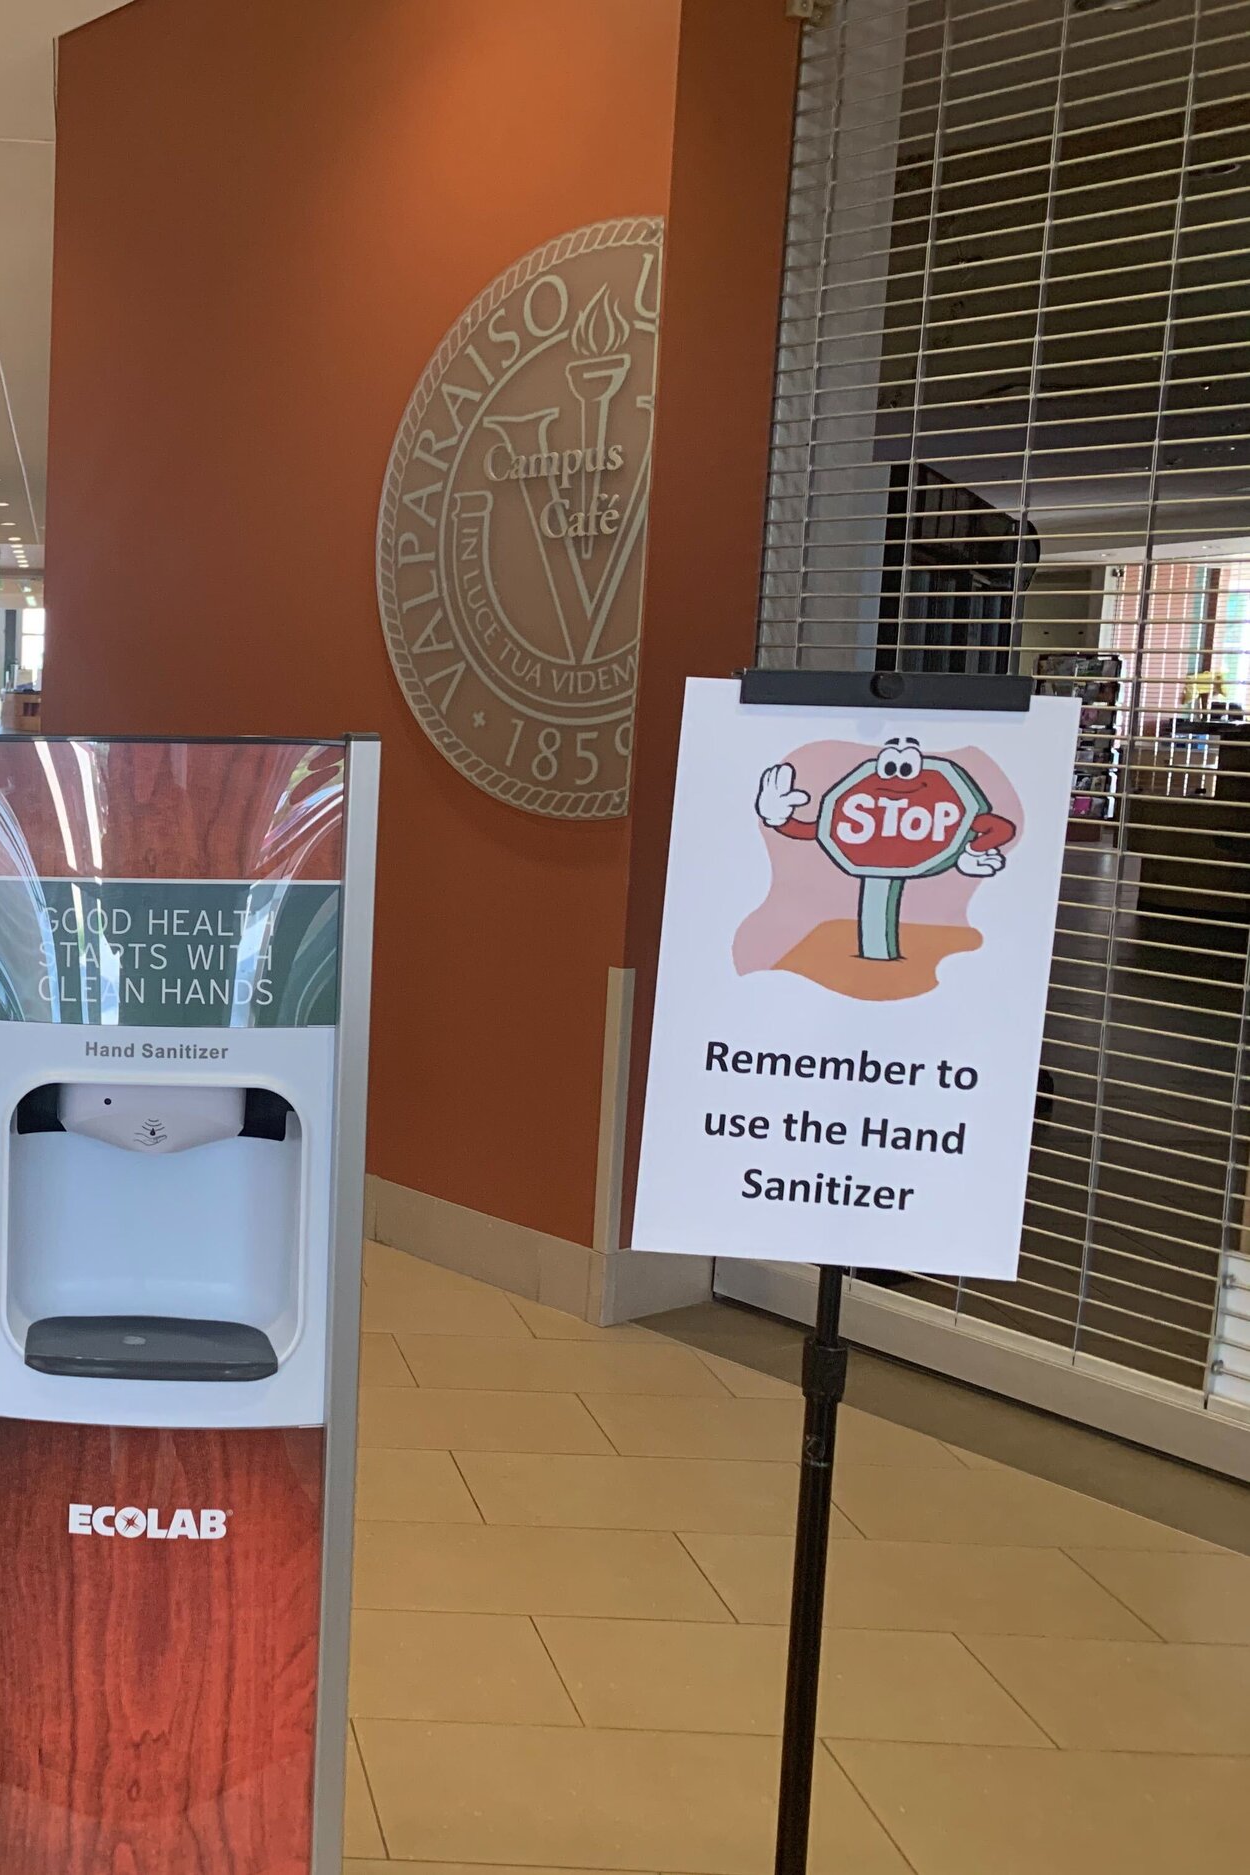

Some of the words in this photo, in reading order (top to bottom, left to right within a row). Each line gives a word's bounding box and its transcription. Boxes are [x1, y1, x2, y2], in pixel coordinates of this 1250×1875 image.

[483, 444, 624, 489] Campus
[398, 274, 568, 715] VALPARAISO
[540, 493, 620, 539] Café
[461, 527, 479, 561] IN
[463, 570, 500, 645] LUCE
[500, 638, 542, 688] TUA
[836, 793, 962, 845] STOP
[39, 906, 132, 935] GOOD
[149, 908, 275, 937] HEALTH
[38, 941, 167, 971] STARTS
[186, 943, 273, 971] WIH
[38, 975, 145, 1004] CLEAN
[161, 977, 274, 1006] HANDS
[85, 1041, 135, 1058] Hand
[141, 1042, 229, 1060] Sanitizer
[705, 1041, 925, 1086] Remember
[936, 1060, 979, 1091] to
[704, 1112, 770, 1139] use
[782, 1111, 848, 1146] the
[861, 1117, 967, 1155] Hand
[740, 1168, 915, 1211] Sanitizer
[68, 1503, 228, 1540] ECOLAB
